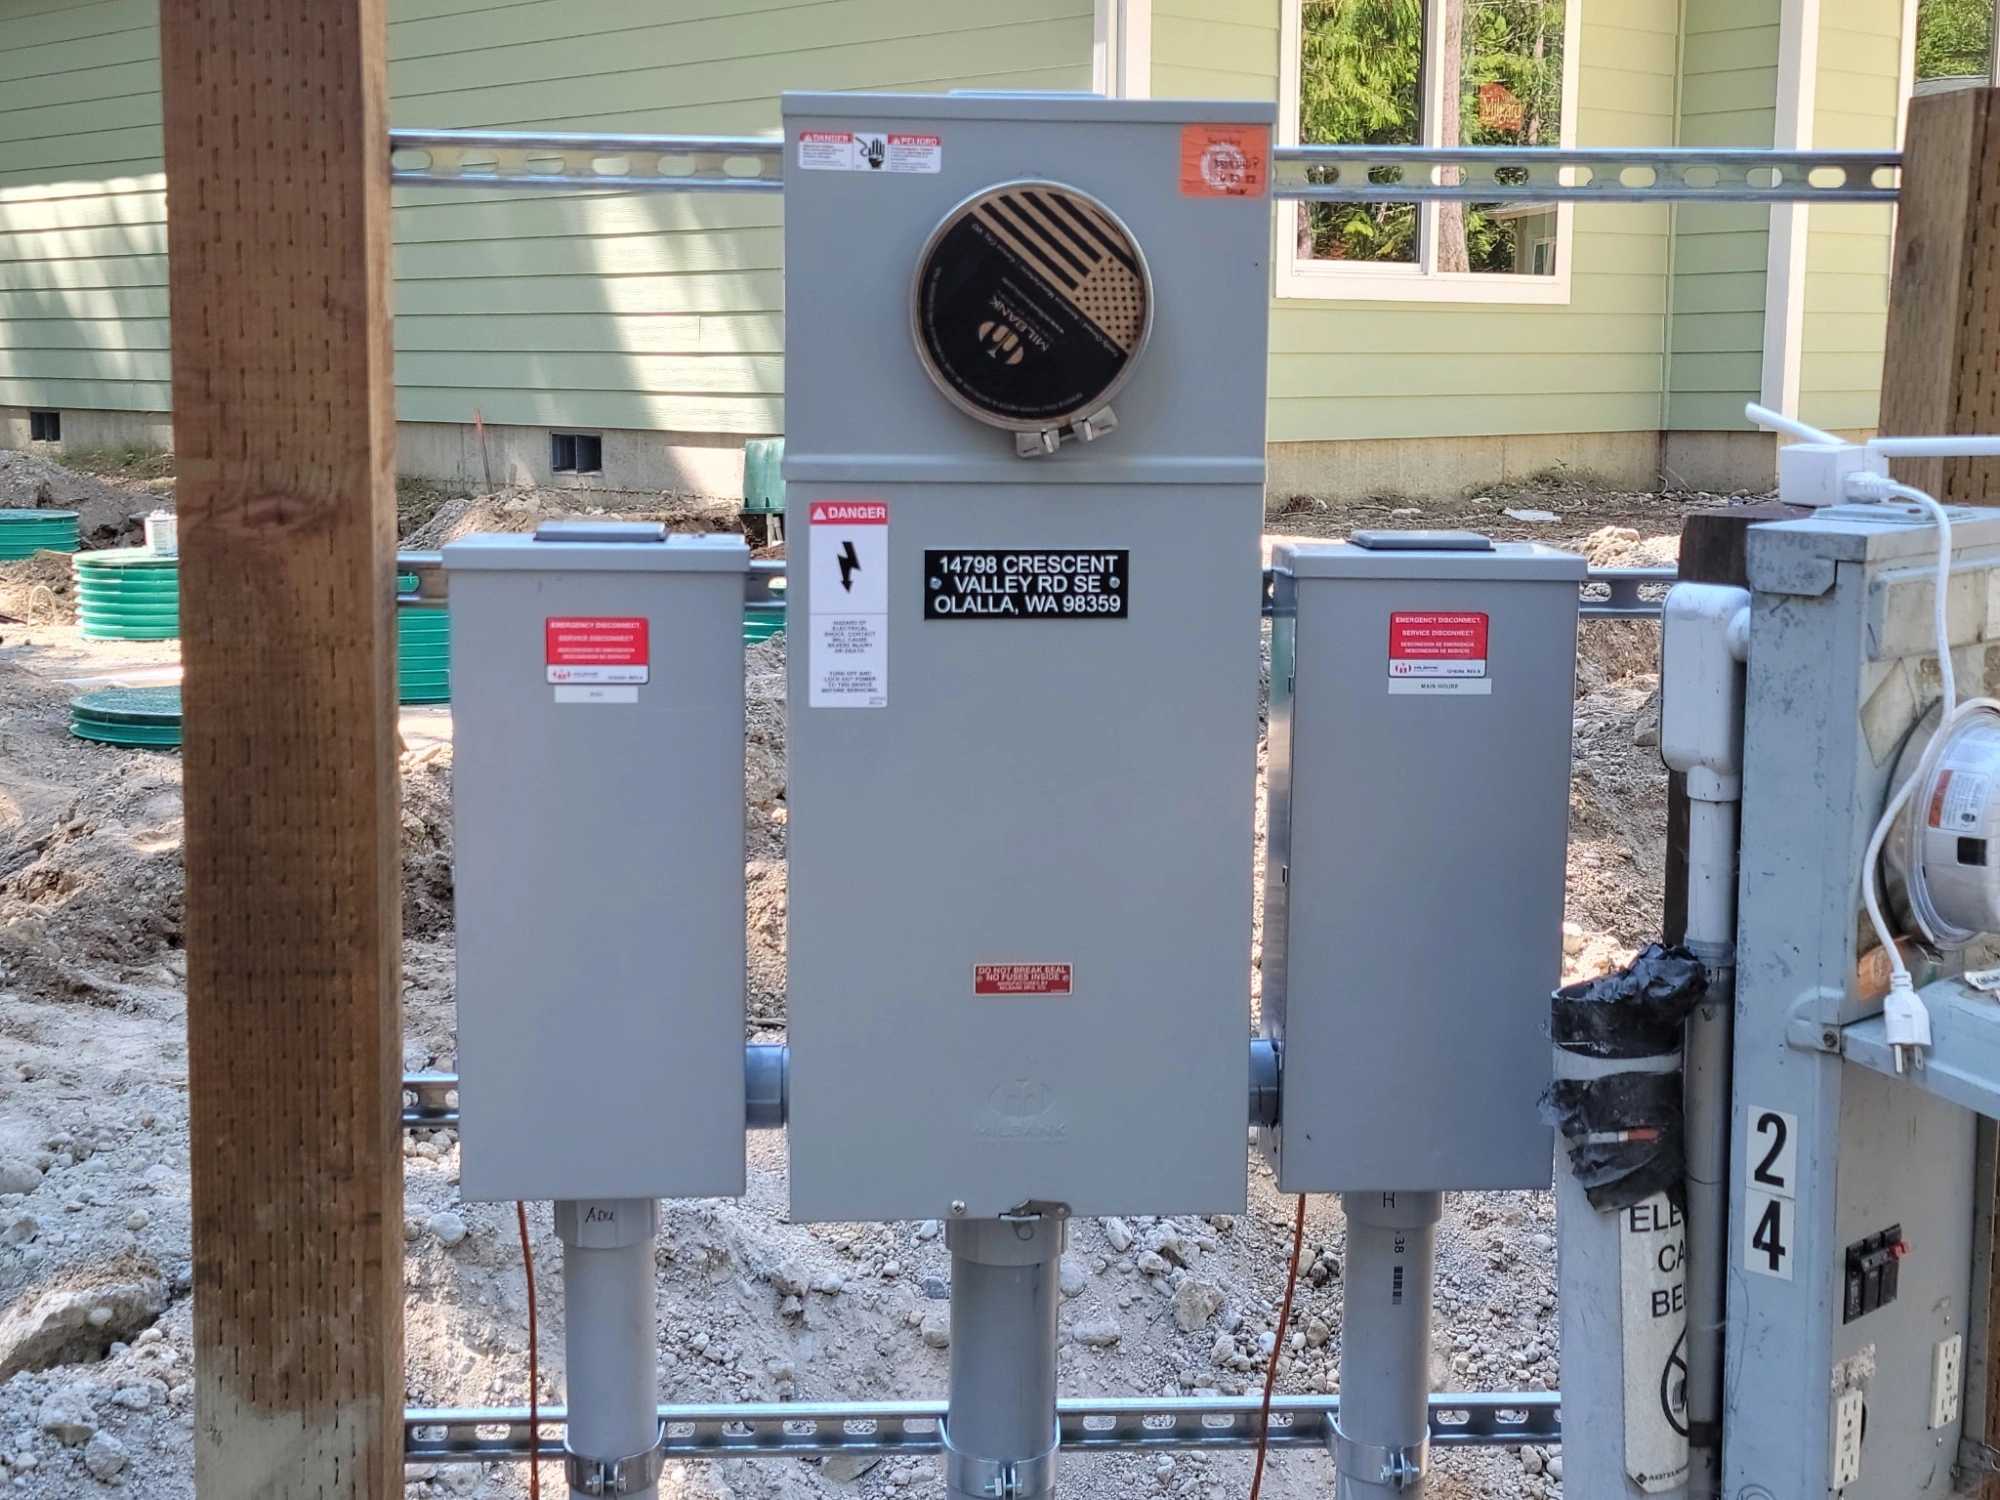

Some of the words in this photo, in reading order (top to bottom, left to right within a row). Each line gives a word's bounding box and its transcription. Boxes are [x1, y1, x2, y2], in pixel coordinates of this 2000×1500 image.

[1482, 96, 1521, 124] Milgard
[813, 134, 849, 142] DANGER
[901, 136, 938, 146] PELIGRO
[988, 295, 1050, 351] MILBANK
[828, 507, 886, 519] DANGER
[940, 556, 998, 574] 14798
[1002, 556, 1118, 574] CRESCENT
[954, 576, 1033, 593] VALLEY
[1038, 576, 1068, 593] RD
[1073, 576, 1101, 593] SE
[934, 595, 1019, 615] OLALLA,
[1024, 596, 1058, 612] WA
[1062, 595, 1120, 612] 98359
[1754, 1112, 1788, 1188] 2
[1752, 1200, 1786, 1272] 4
